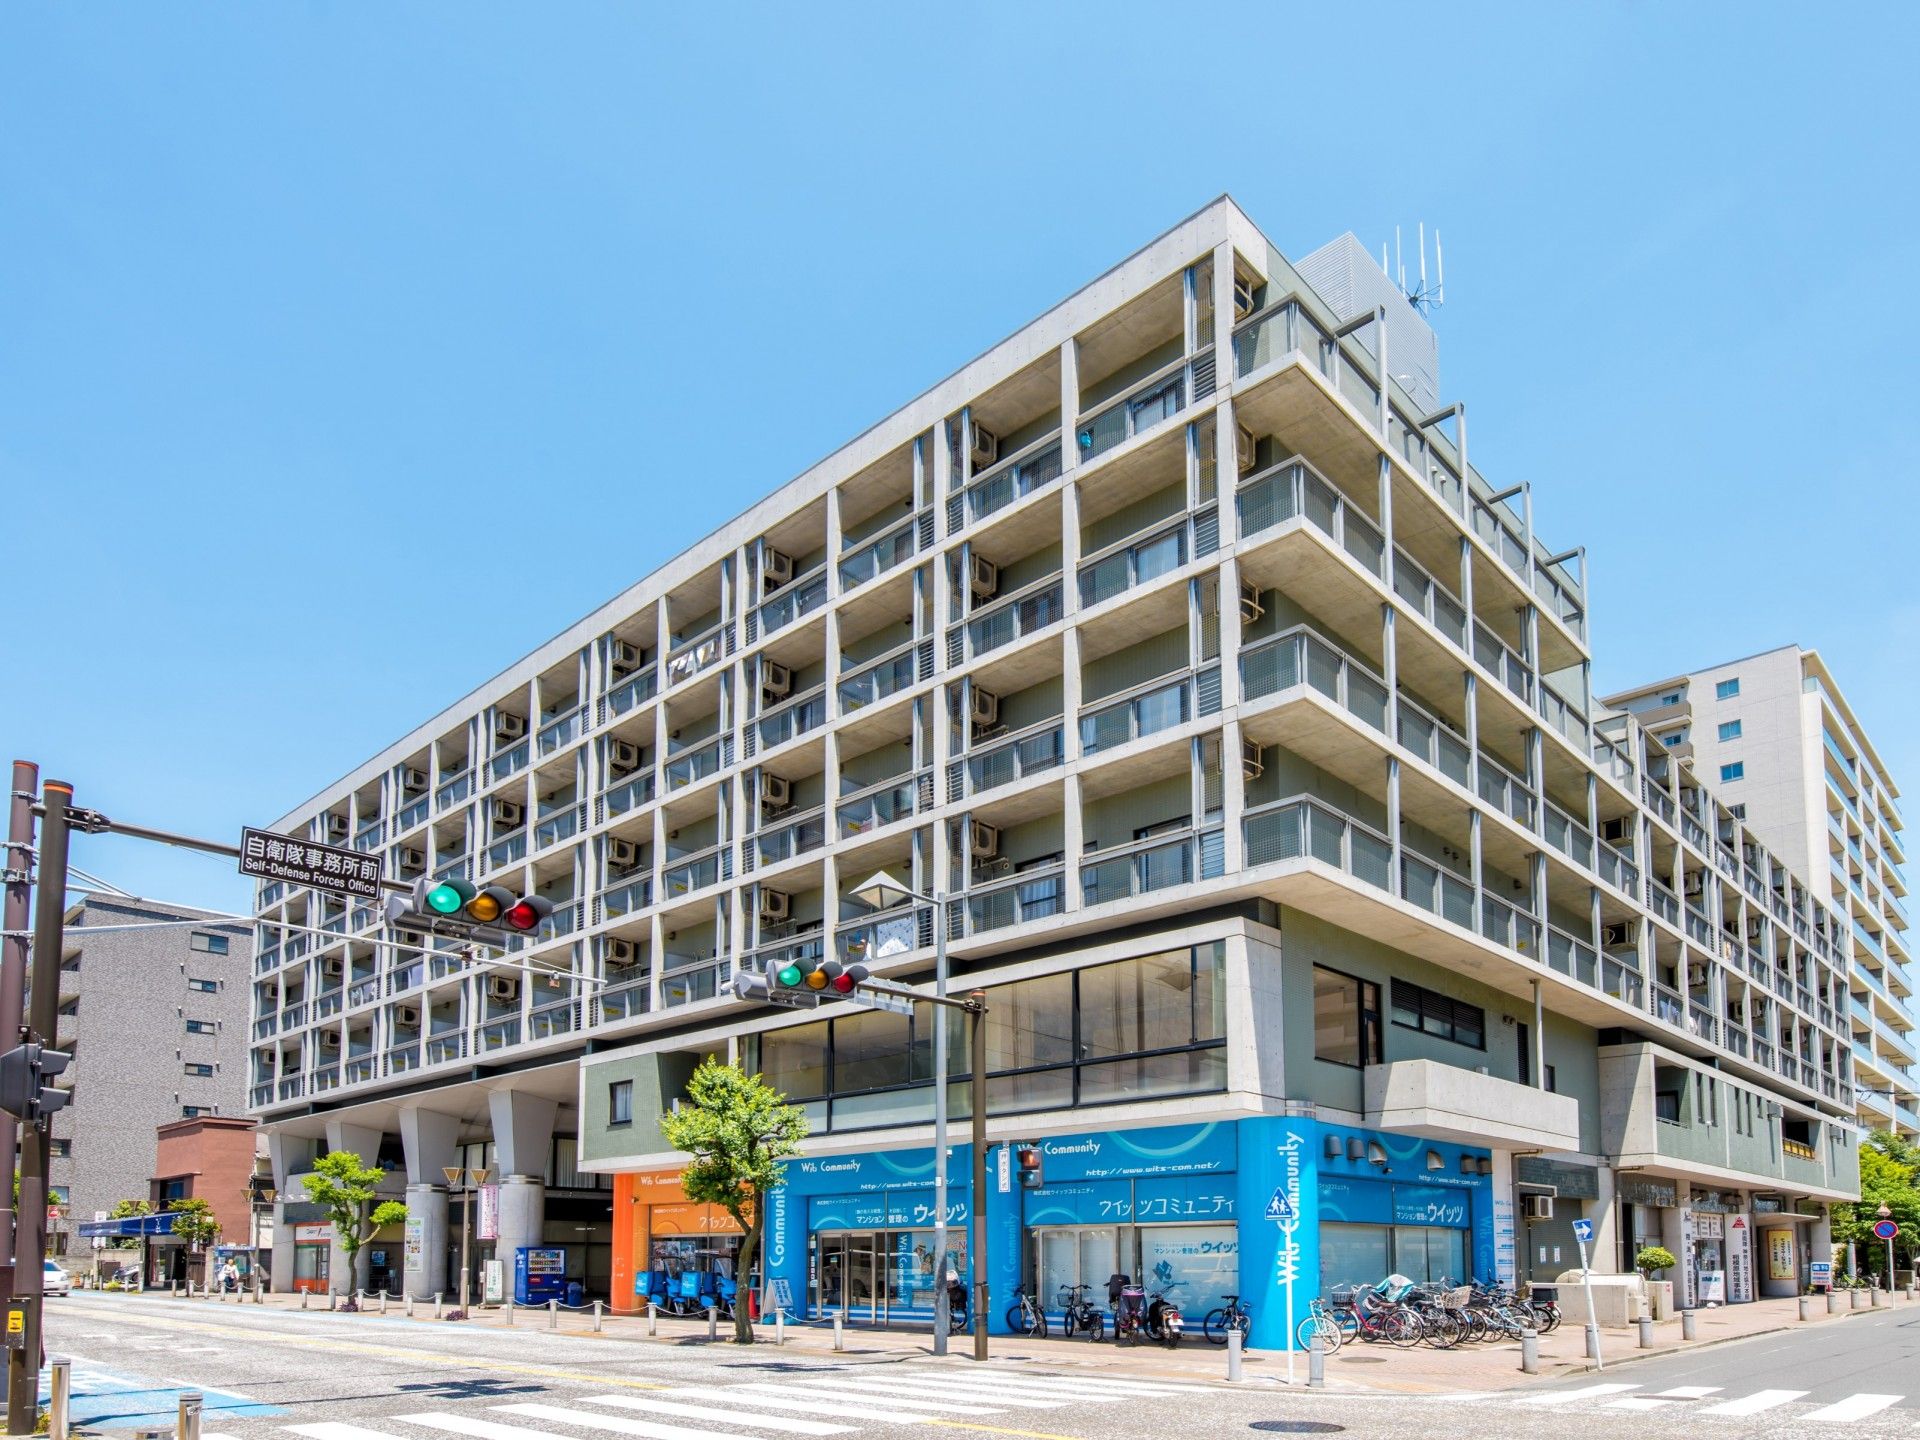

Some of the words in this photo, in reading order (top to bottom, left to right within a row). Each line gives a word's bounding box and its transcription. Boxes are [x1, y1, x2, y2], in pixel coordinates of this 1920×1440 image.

[247, 836, 378, 881] 自衛隊事務所前
[245, 858, 310, 881] Self-Defense
[313, 871, 345, 889] Forces
[348, 879, 376, 894] Office
[1044, 1139, 1101, 1155] Community
[821, 1159, 861, 1173] Community
[1086, 1161, 1221, 1177] http://www.wits-com.net/
[1099, 1196, 1235, 1217] ウイッツコミュニティ
[1427, 1203, 1464, 1224] ウイッツ
[1003, 1213, 1019, 1272] Community
